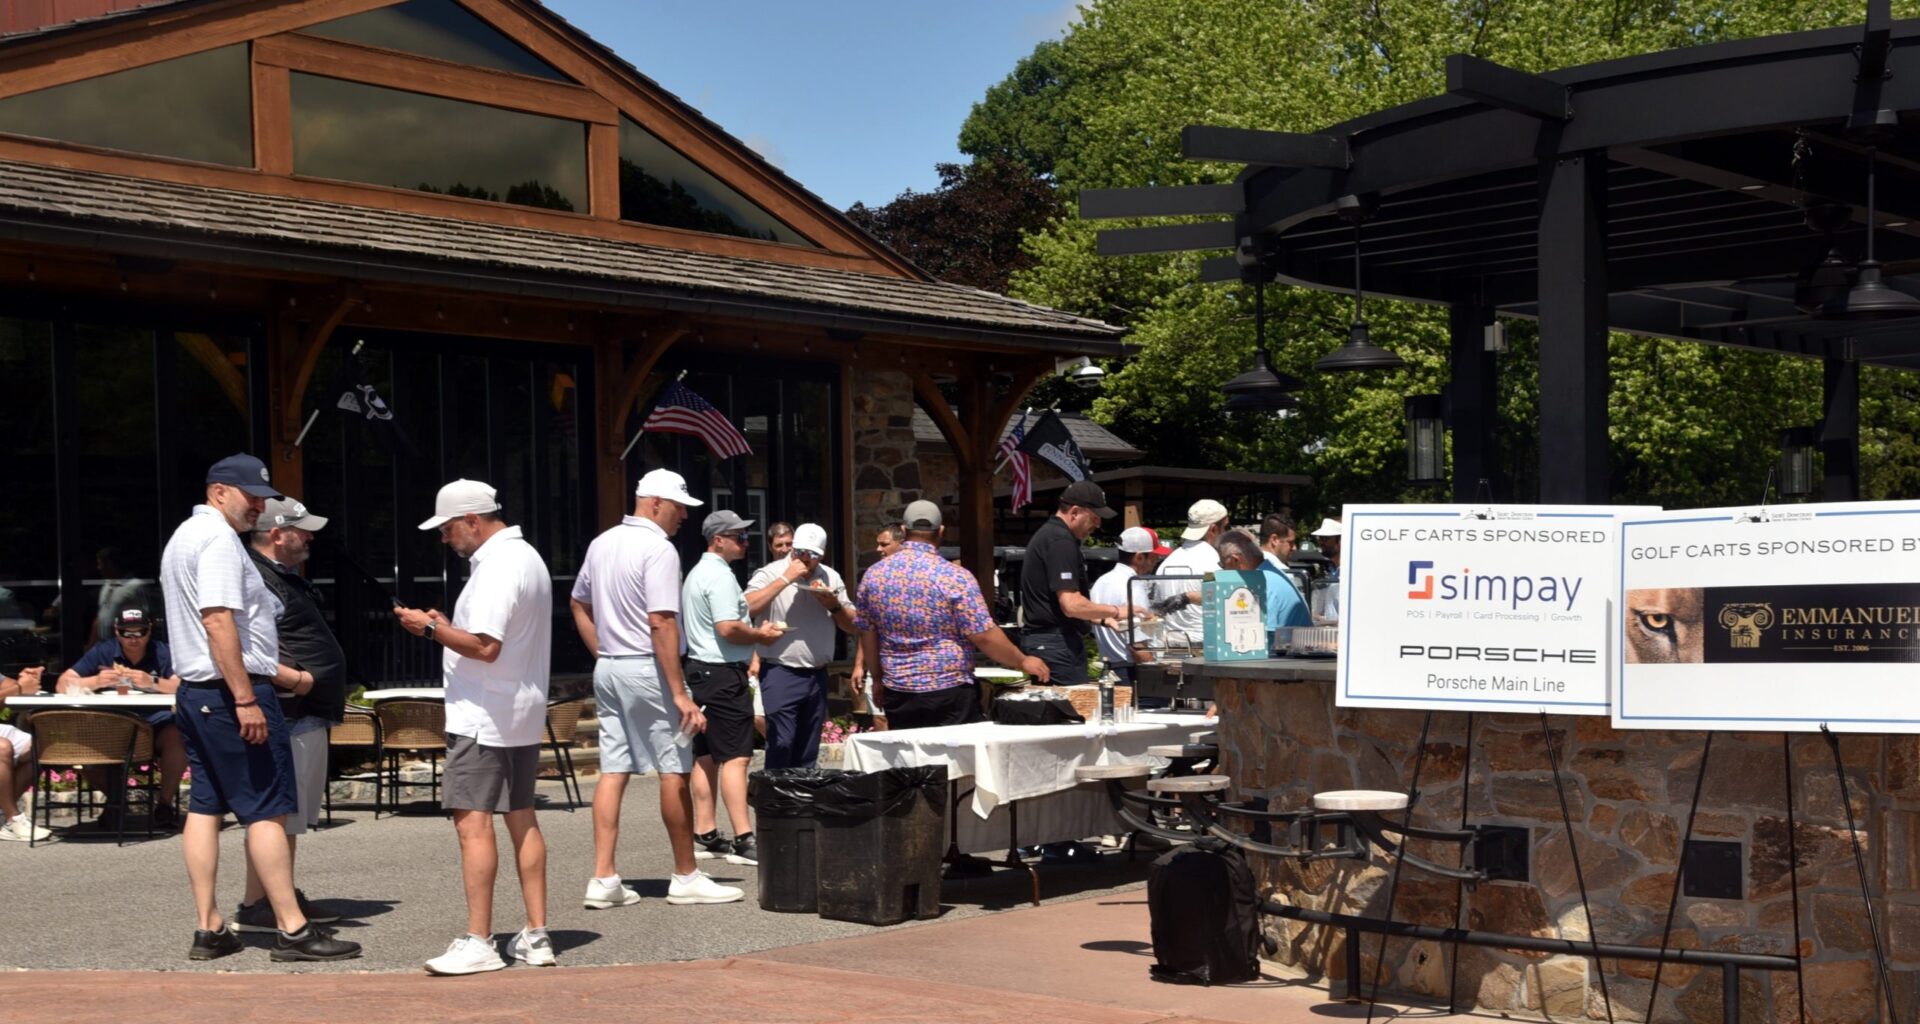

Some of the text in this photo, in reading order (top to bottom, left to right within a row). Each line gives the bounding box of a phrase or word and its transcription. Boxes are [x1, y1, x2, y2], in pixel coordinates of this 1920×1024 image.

[1360, 528, 1606, 543] GOLF CARTS SPONSORED
[1631, 537, 1920, 560] GOLF CARTS SPONSORED B
[1440, 568, 1583, 611] simpay
[1406, 610, 1583, 622] POS Payroll Card Processing Growth
[1399, 645, 1597, 664] PORSCHE
[1427, 674, 1565, 693] Porsche Main Line
